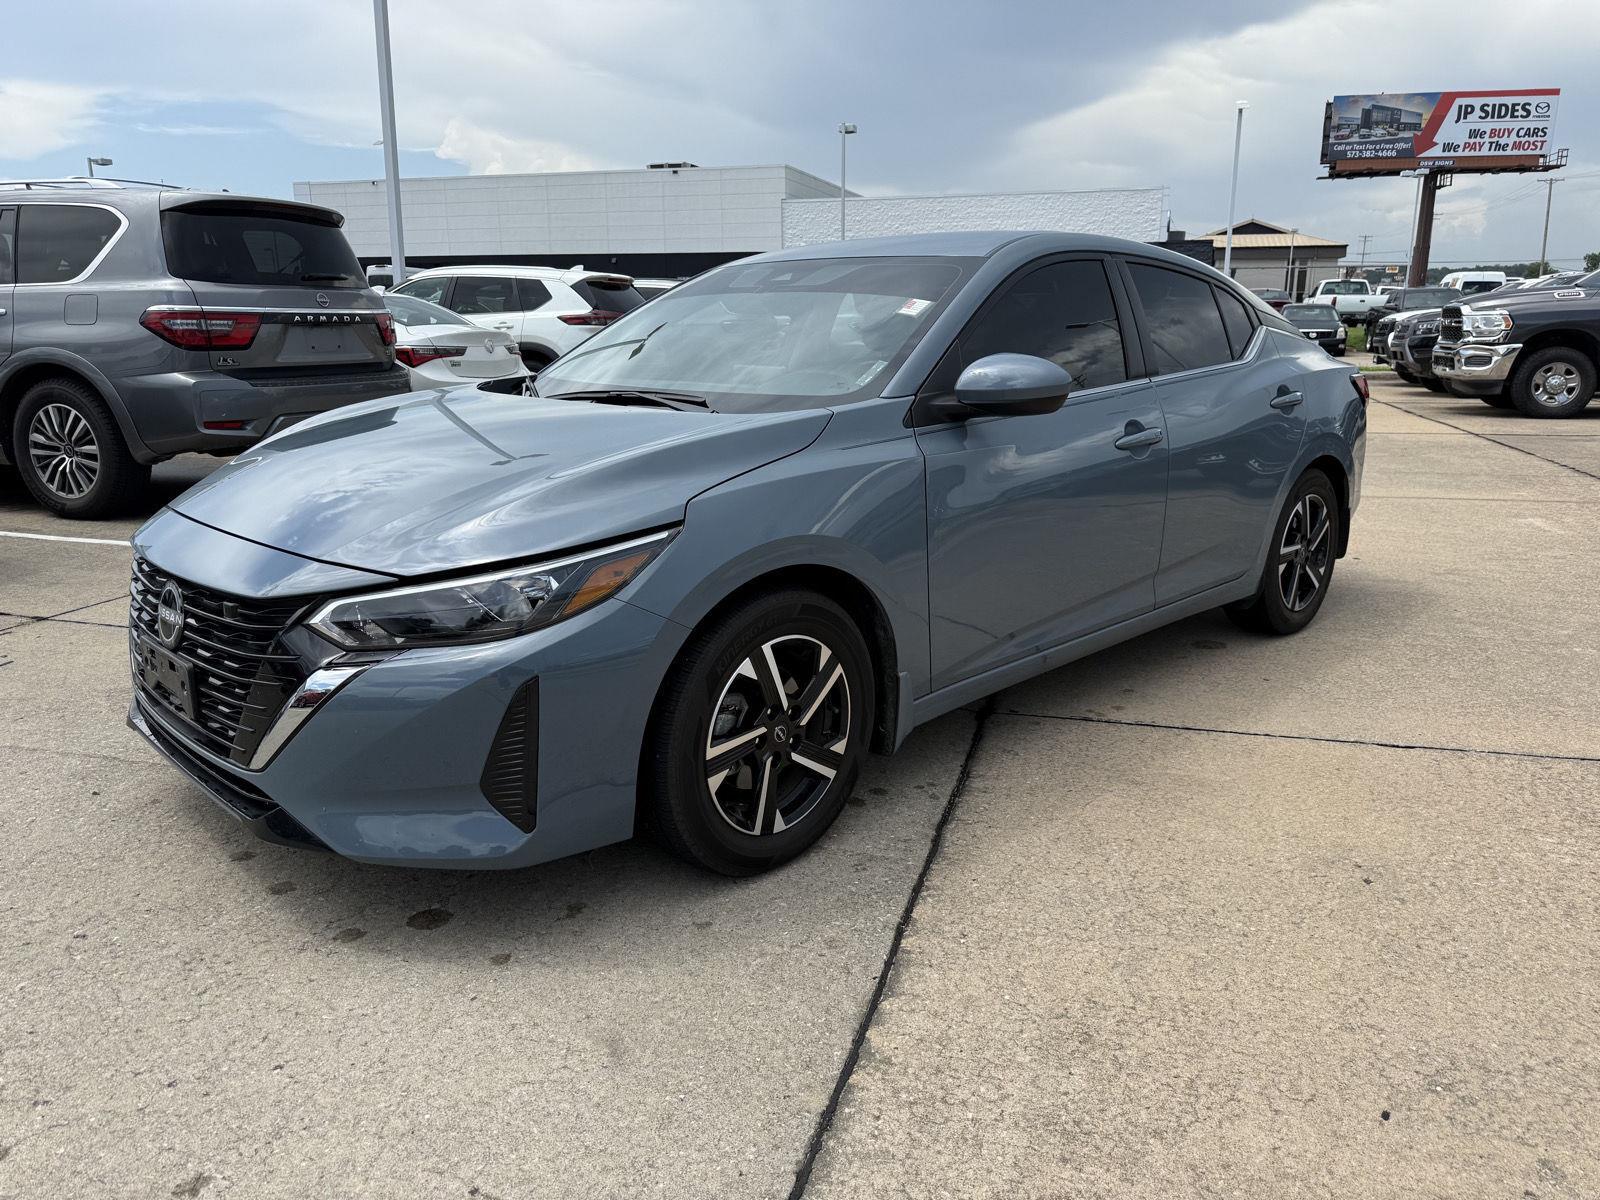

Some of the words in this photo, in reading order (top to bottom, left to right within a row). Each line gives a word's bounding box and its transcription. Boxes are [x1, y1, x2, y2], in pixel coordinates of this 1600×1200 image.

[1455, 104, 1475, 123] JP
[1478, 102, 1532, 120] SIDES
[1468, 128, 1487, 139] We
[1488, 128, 1515, 139] BUY
[1516, 127, 1548, 138] CARS
[1441, 142, 1460, 153] We
[1461, 141, 1486, 152] PAY
[1487, 140, 1509, 152] The
[1510, 140, 1547, 151] MOST
[1346, 149, 1397, 158] 573-382-4666
[294, 315, 361, 323] ARMADA
